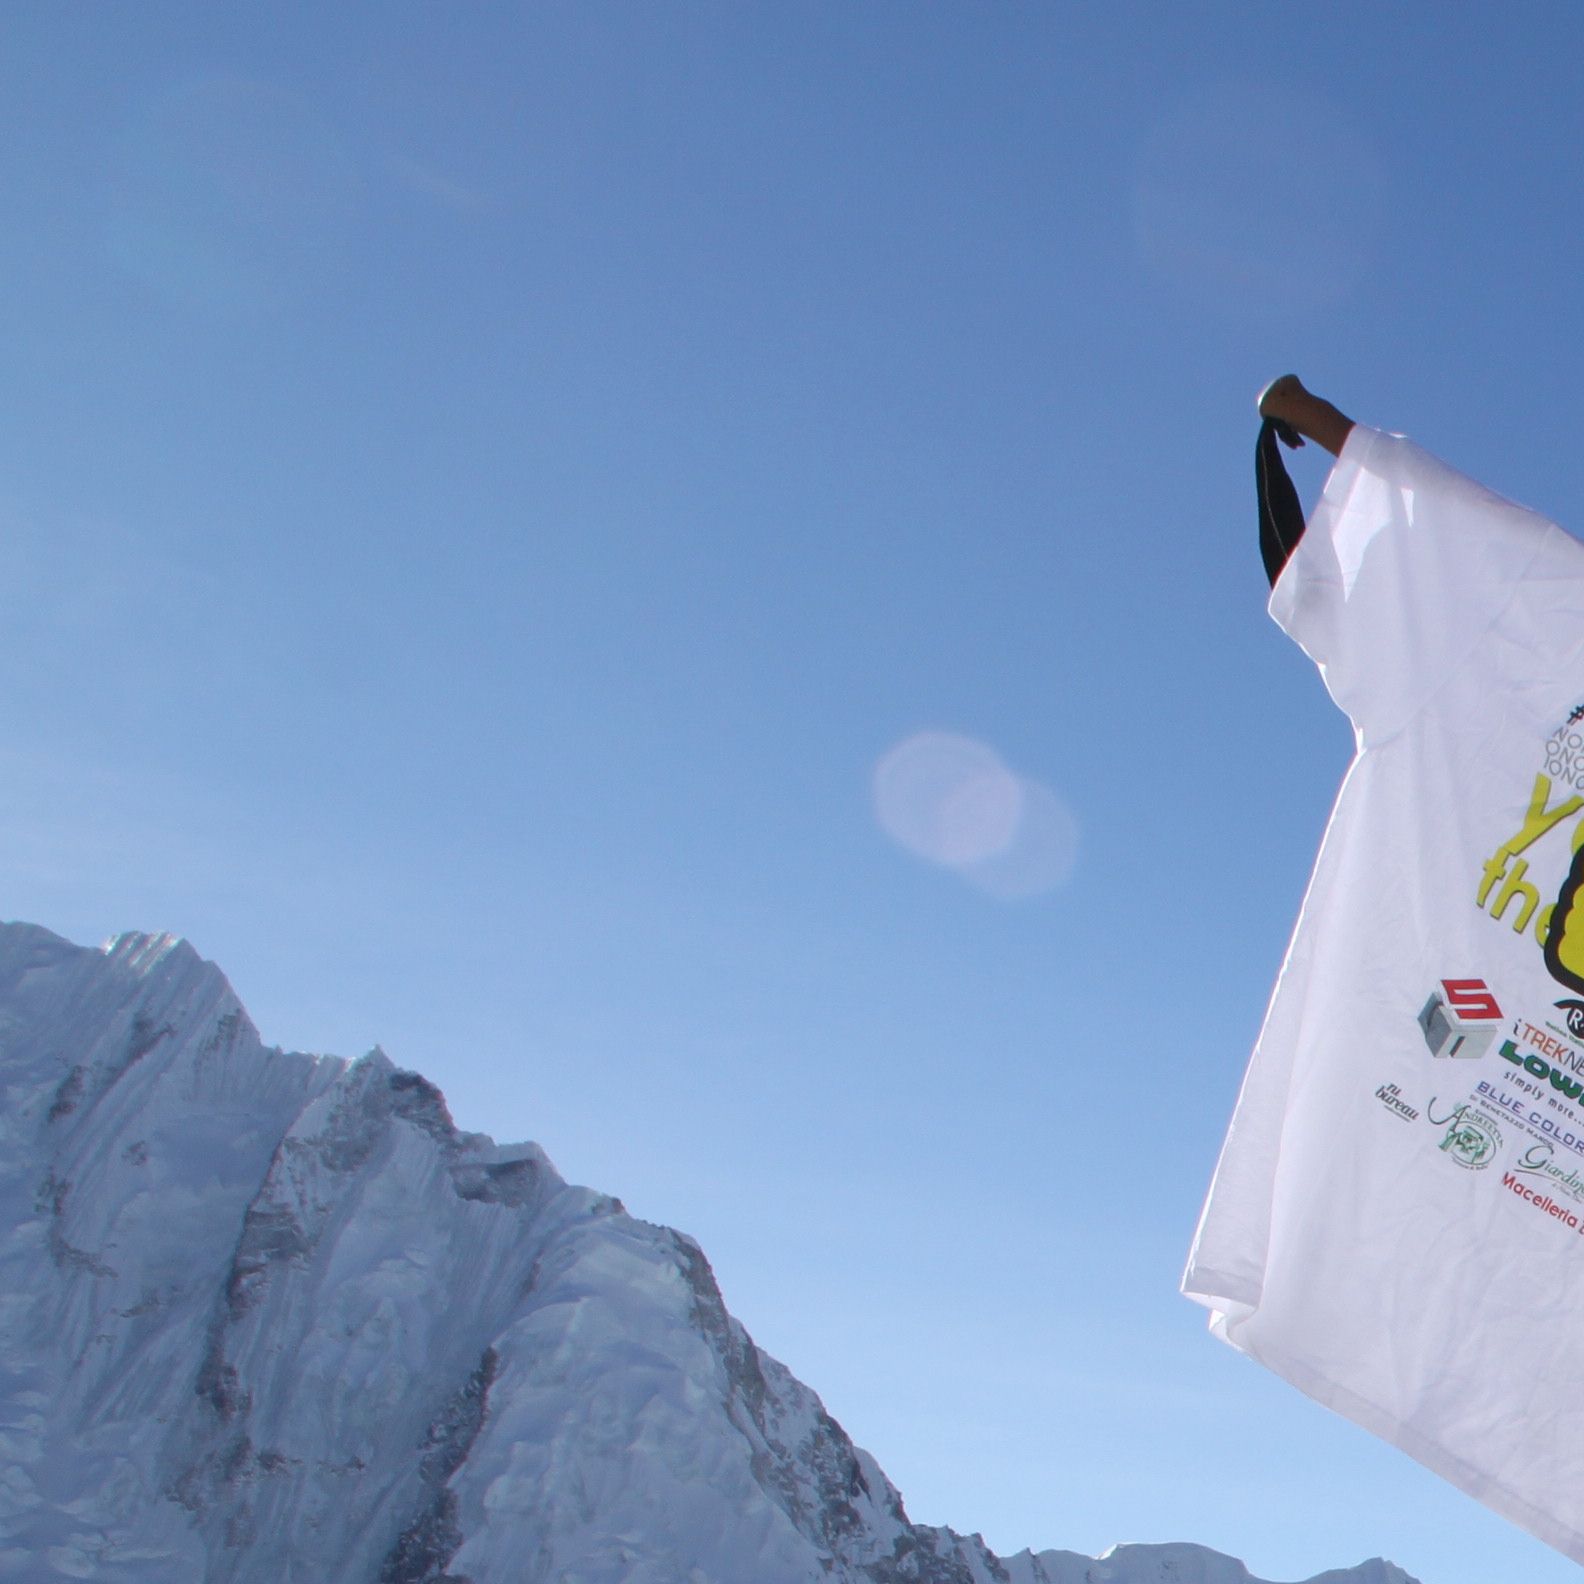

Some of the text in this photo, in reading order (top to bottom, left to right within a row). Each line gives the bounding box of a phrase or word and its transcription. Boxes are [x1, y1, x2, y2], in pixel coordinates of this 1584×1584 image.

[1375, 1085, 1420, 1121] bureau
[1477, 1081, 1525, 1114] BLUE
[1503, 1071, 1545, 1101] simply
[1502, 1171, 1578, 1229] Macelleria
